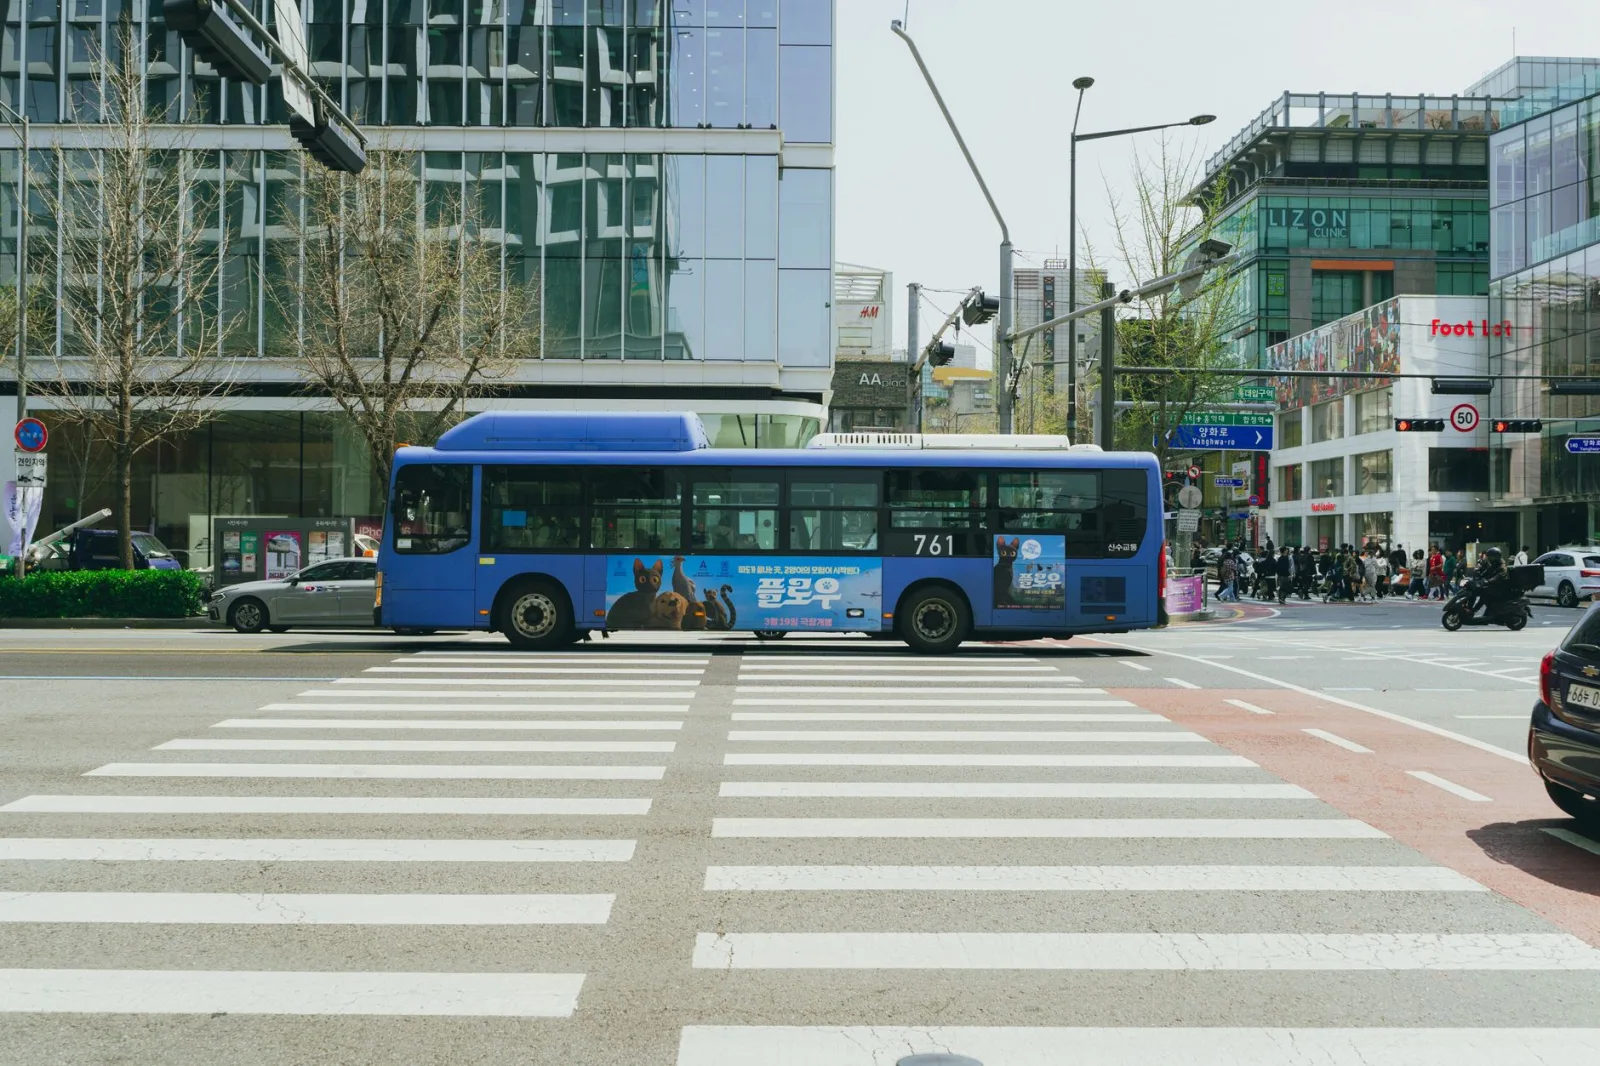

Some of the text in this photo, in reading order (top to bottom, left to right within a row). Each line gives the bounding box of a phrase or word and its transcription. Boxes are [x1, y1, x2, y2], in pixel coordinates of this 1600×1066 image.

[1269, 209, 1347, 227] LIZON
[1314, 228, 1347, 237] CLINIC
[1431, 319, 1475, 337] Foot
[1203, 415, 1225, 423] 홍익대
[1242, 415, 1264, 424] 합정역
[1457, 412, 1473, 424] 50
[1199, 427, 1229, 437] 양화로
[1192, 438, 1235, 446] Yanghwa-ro
[17, 457, 45, 466] 견인지역
[359, 526, 382, 536] iPho
[914, 534, 953, 556] 761
[1108, 543, 1137, 551] 신수교통
[1018, 572, 1062, 589] 플로우
[756, 577, 842, 610] 플로우
